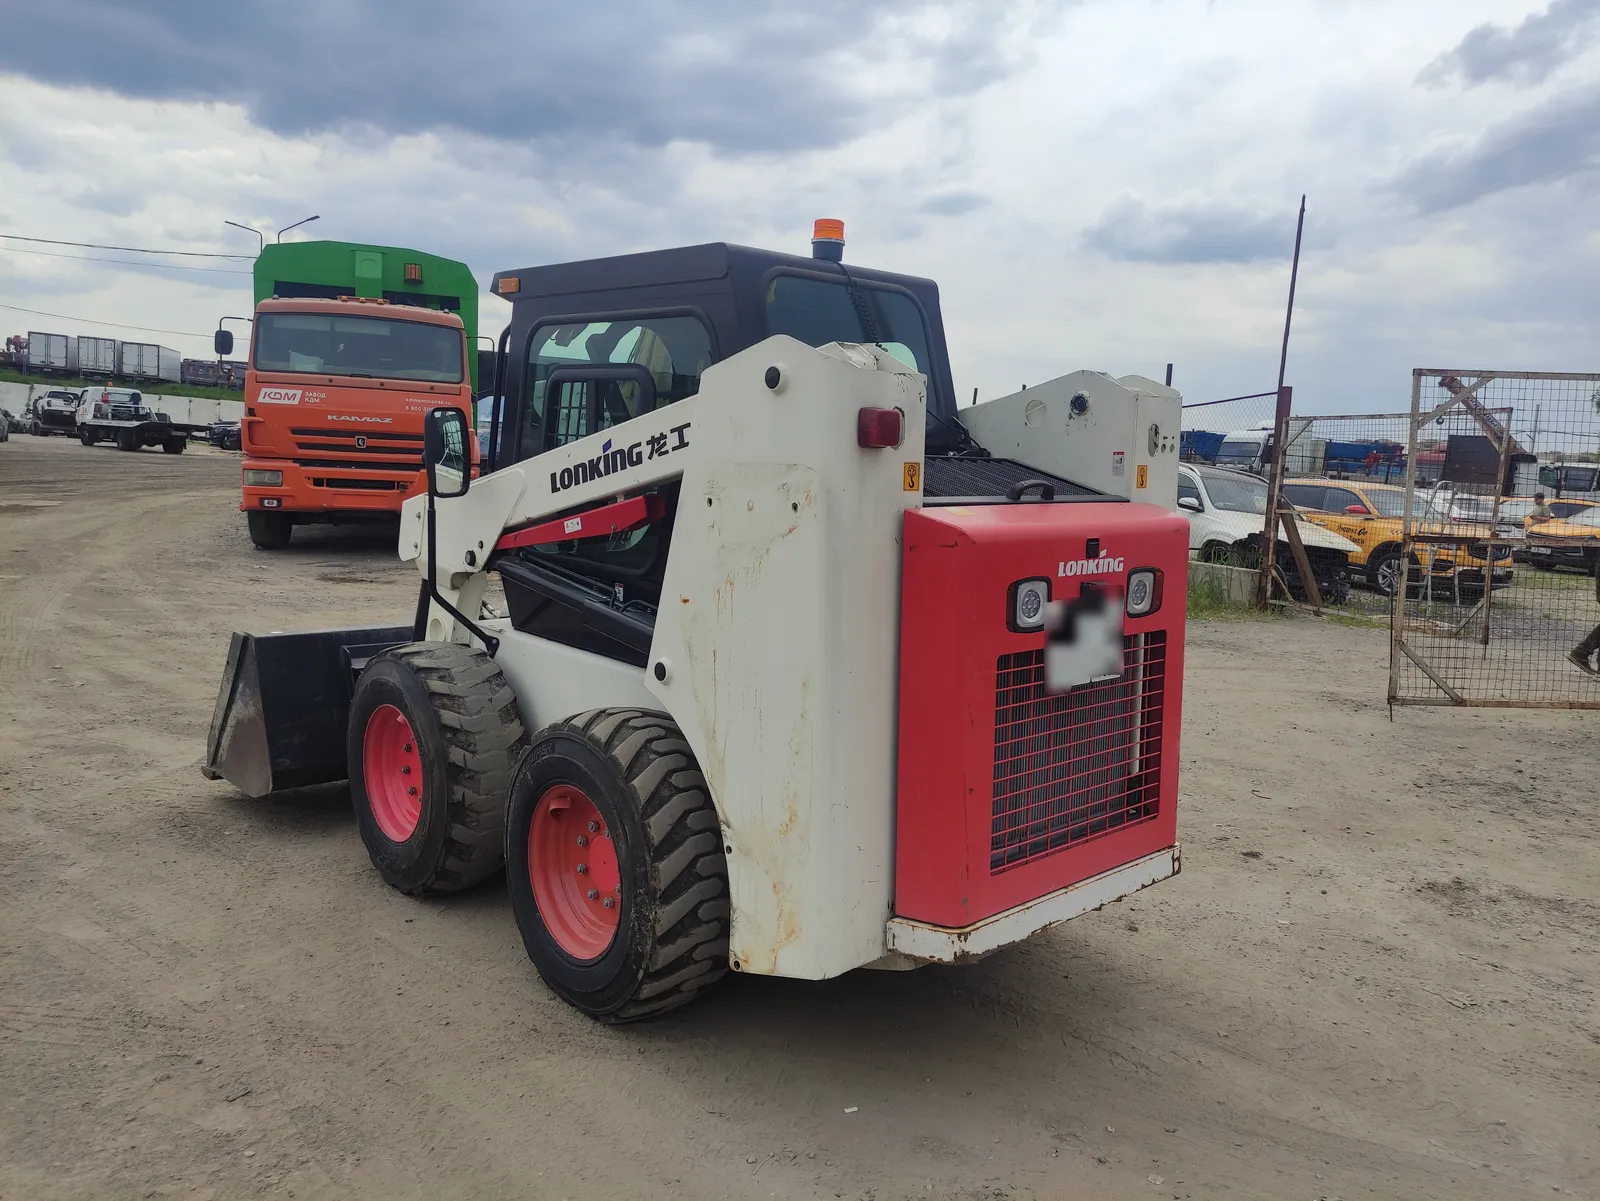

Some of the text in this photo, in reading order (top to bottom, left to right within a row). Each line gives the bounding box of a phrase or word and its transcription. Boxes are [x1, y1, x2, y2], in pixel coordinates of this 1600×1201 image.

[262, 391, 298, 402] KDM
[327, 415, 393, 424] KAMAZ
[646, 422, 691, 461] 龙工
[1357, 527, 1368, 536] Go
